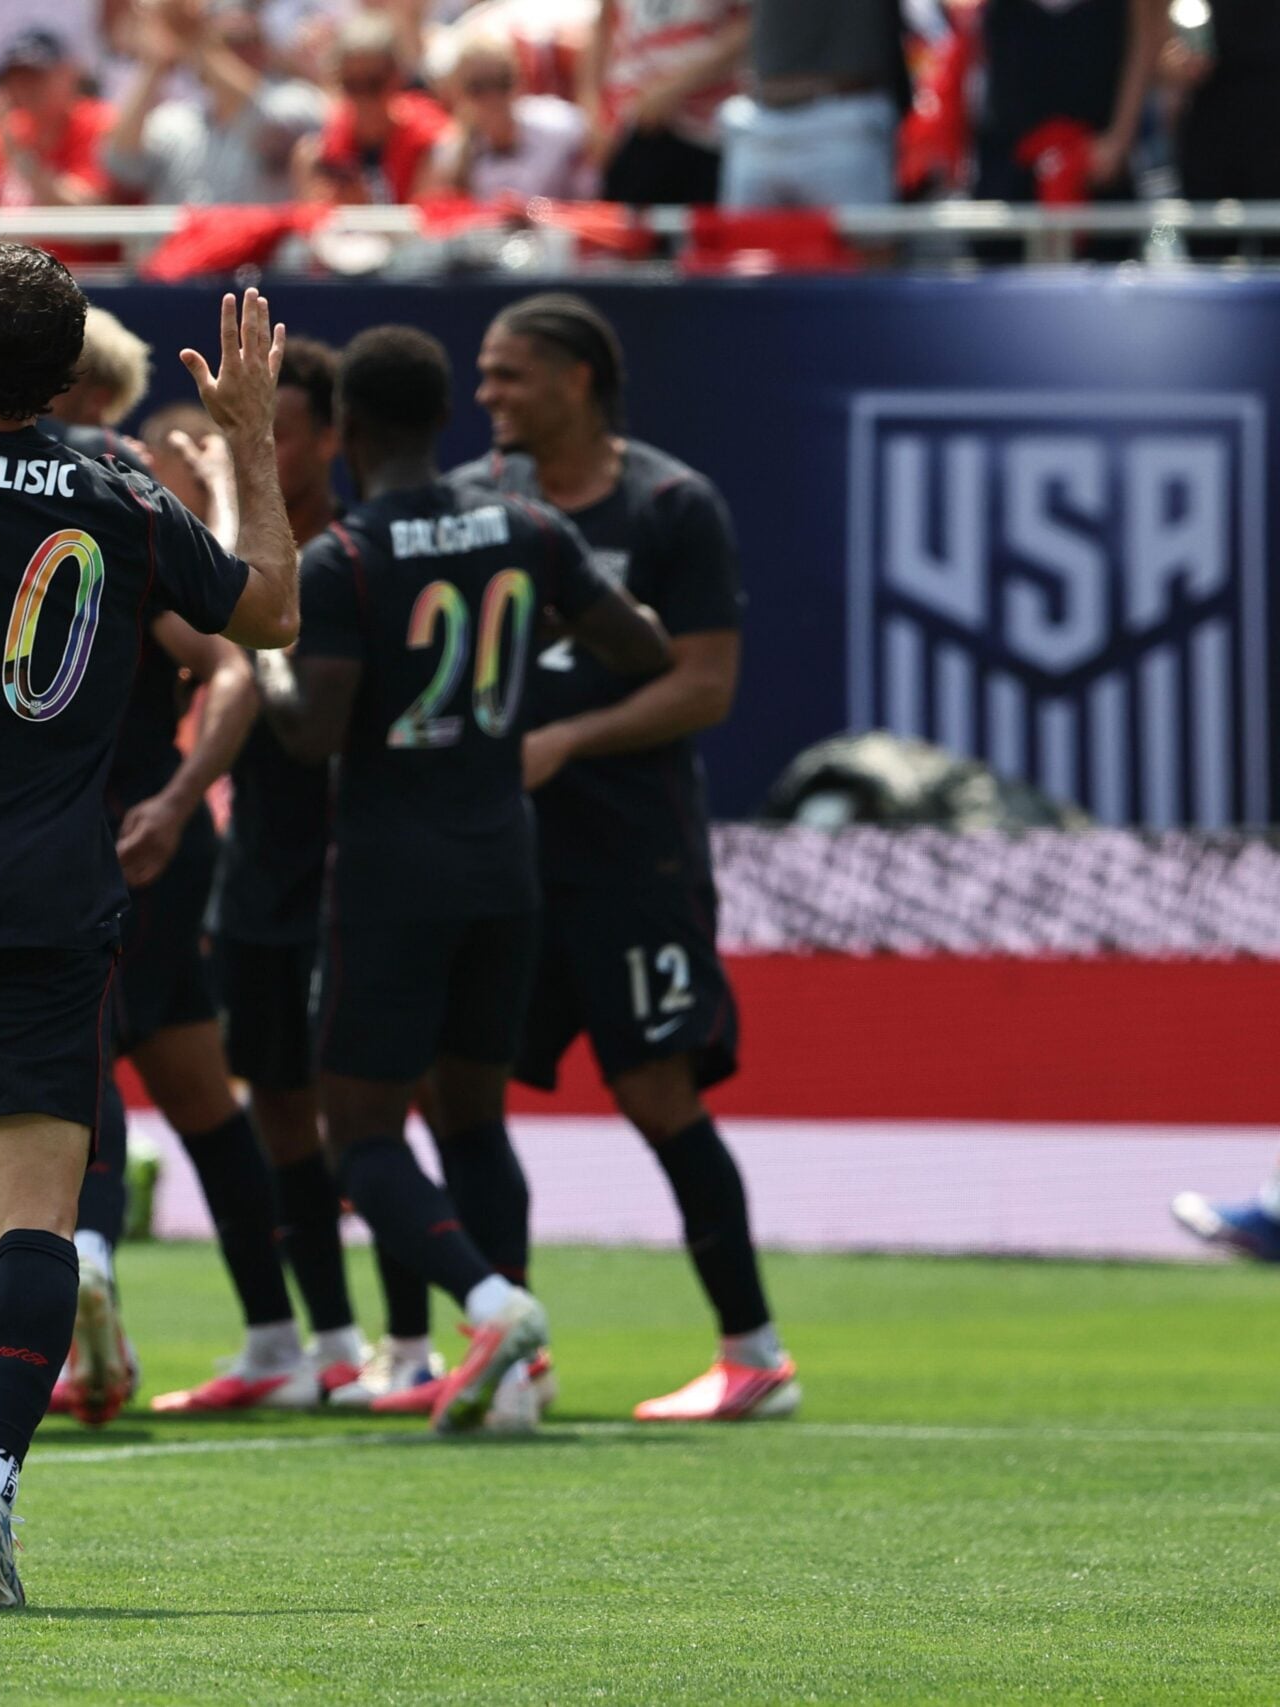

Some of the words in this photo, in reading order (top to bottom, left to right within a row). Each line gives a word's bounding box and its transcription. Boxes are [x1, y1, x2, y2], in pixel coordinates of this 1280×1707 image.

[881, 432, 1228, 676] USA
[386, 567, 535, 748] 20
[626, 942, 696, 1020] 12
